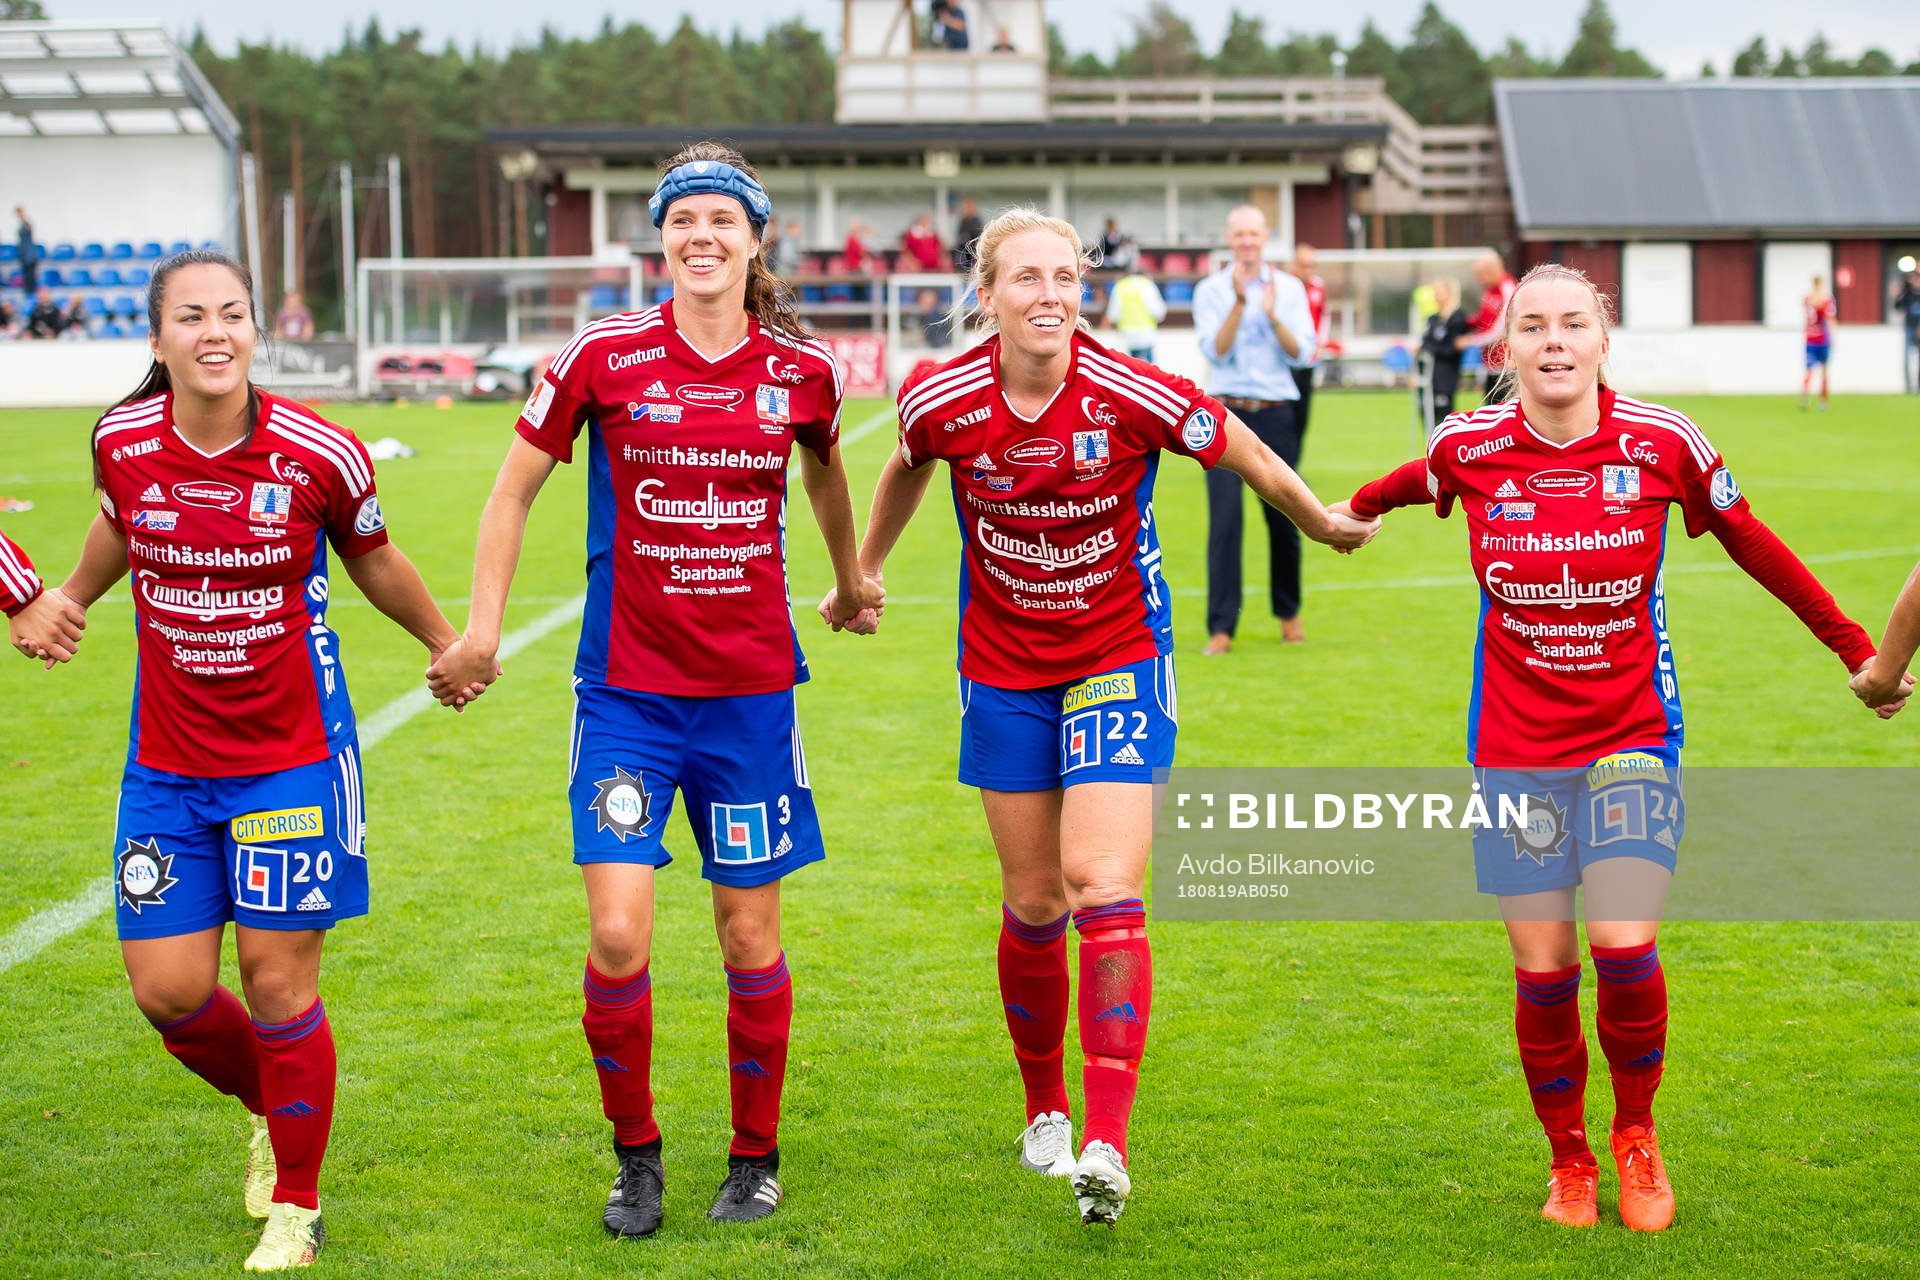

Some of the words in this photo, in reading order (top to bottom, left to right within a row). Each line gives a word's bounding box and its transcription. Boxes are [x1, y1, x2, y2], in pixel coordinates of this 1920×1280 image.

[608, 345, 667, 371] Contura
[779, 369, 805, 385] SHG
[643, 390, 671, 399] adidas
[651, 404, 680, 413] INTER
[651, 413, 680, 422] SPORT
[1094, 409, 1117, 426] SHG
[122, 437, 163, 460] NIBE
[623, 444, 784, 470] #mitthässleholm
[1457, 434, 1514, 463] Contura
[1632, 446, 1659, 465] SHG
[282, 465, 310, 486] SHG
[140, 494, 166, 503] adidas
[635, 478, 768, 530] Emmaljunga
[966, 490, 1119, 518] #mitthässleholm
[1494, 490, 1521, 498] adidas
[147, 511, 176, 521] INTER
[1504, 503, 1534, 511] INTER
[1505, 511, 1534, 520] SPORT
[148, 520, 175, 530] SPORT
[977, 515, 1119, 572] Emmaljunga
[1481, 526, 1645, 552] #mitthässleholm
[131, 535, 292, 567] #mitthässleholm
[633, 540, 772, 563] Snapphanebygdens
[670, 564, 745, 583] Sparbank
[984, 558, 1119, 594] Snapphanebygdens
[138, 569, 285, 622] Emmaljunga
[1485, 561, 1644, 610] Emmaljunga
[1013, 593, 1084, 610] Sparbank
[1502, 612, 1636, 639] Snapphanebygdens
[173, 645, 247, 664] Sparbank
[1533, 641, 1604, 658] Sparbank
[1085, 678, 1130, 701] GROSS
[1106, 710, 1148, 740] 22
[1110, 756, 1145, 765] adidas
[1589, 760, 1615, 785] CITY
[1617, 757, 1663, 777] GROSS
[609, 797, 640, 816] SFA
[778, 794, 791, 825] 3
[1650, 789, 1678, 827] 24
[236, 817, 265, 839] CITY
[270, 812, 318, 835] GROSS
[1524, 818, 1555, 836] SFA
[126, 864, 155, 883] SFA
[292, 850, 333, 883] 20
[297, 901, 331, 911] adidas
